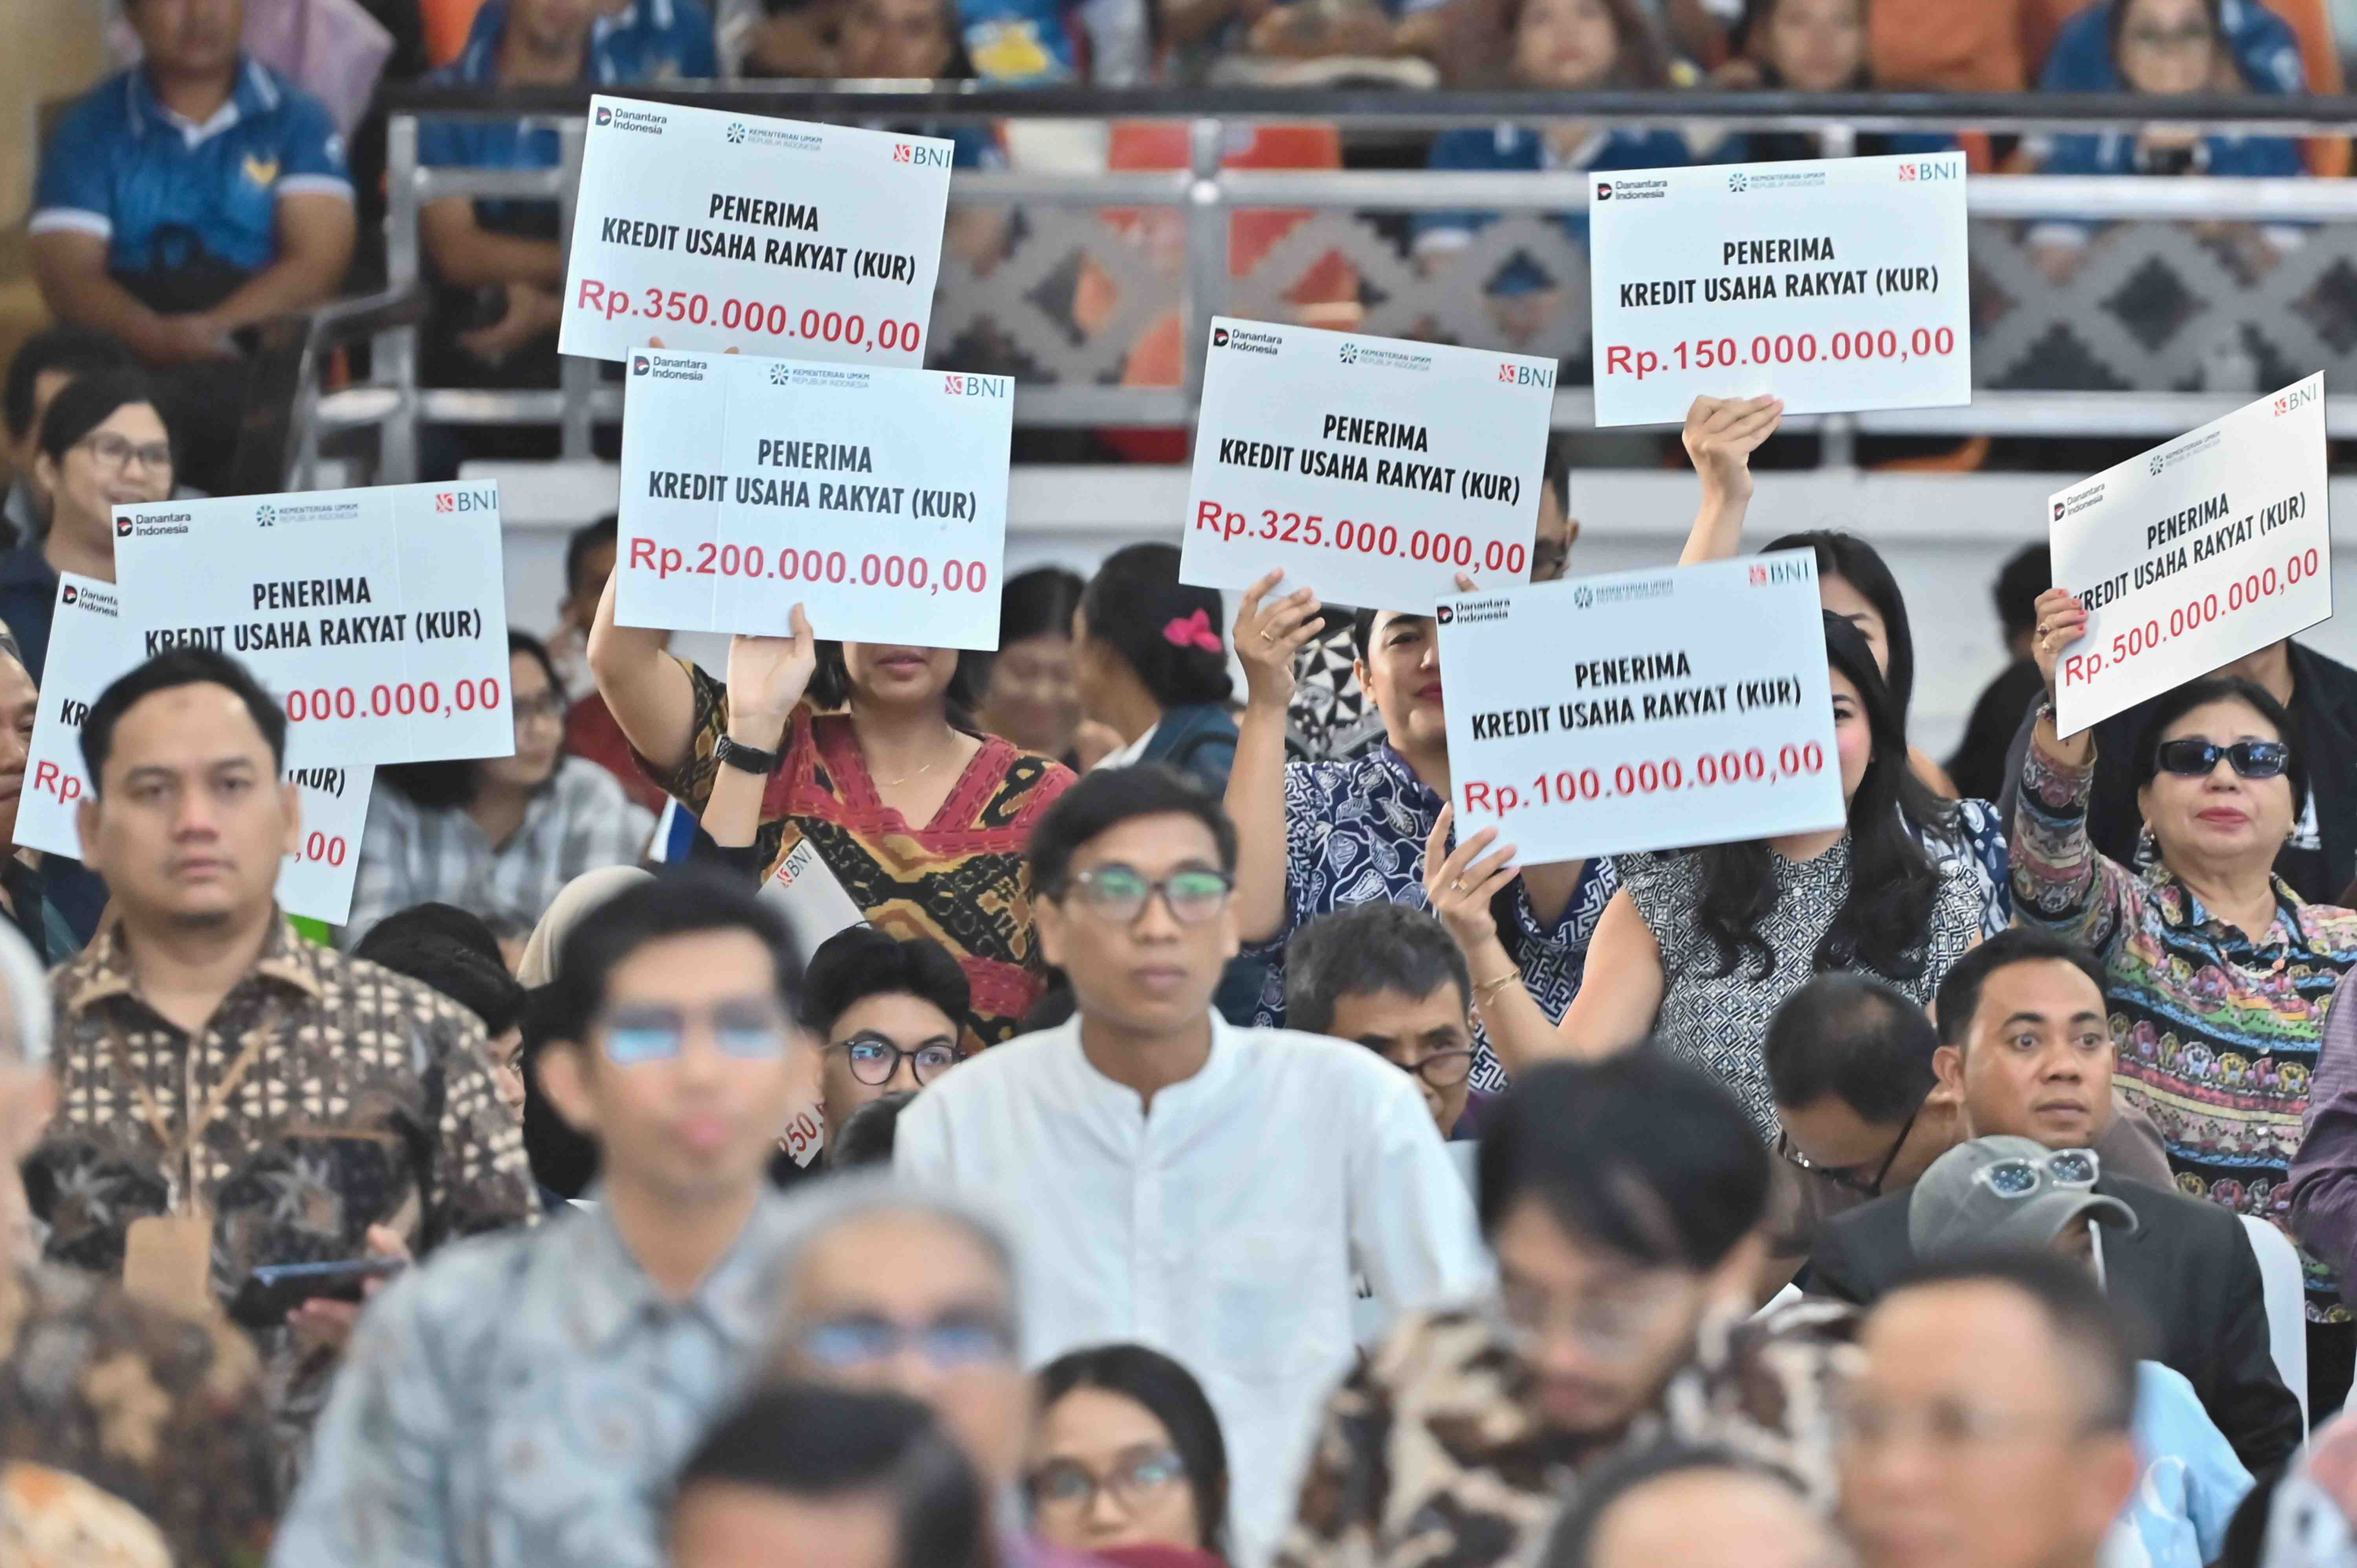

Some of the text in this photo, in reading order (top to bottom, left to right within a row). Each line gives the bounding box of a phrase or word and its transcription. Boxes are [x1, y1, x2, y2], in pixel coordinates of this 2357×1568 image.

[614, 119, 662, 135] Indonesia
[615, 108, 667, 124] Danantara
[913, 146, 951, 168] BNI
[1920, 162, 1956, 180] BNI
[1615, 180, 1668, 190] Danantara
[1616, 191, 1665, 200] Indonesia
[709, 194, 818, 232] PENERIMA
[602, 217, 915, 286] KREDIT USAHA RAKYAT (KUR)
[1724, 237, 1835, 266] PENERIMA
[1620, 265, 1938, 308] KREDIT USAHA RAKYAT (KUR)
[579, 280, 920, 352] Rp.350.000.000,00
[1230, 340, 1278, 355] Indonesia
[1232, 329, 1282, 344] Danantara
[653, 356, 707, 370] Danantara
[1607, 327, 1954, 380] Rp.150.000.000,00
[652, 368, 703, 381] Indonesia
[966, 377, 1004, 398] BNI
[1518, 366, 1553, 388] BNI
[2289, 383, 2317, 411] BNI
[1323, 414, 1428, 452] PENERIMA
[758, 439, 872, 473] PENERIMA
[1219, 438, 1520, 506] KREDIT USAHA RAKYAT (KUR)
[458, 490, 497, 512] BNI
[649, 471, 976, 523] KREDIT USAHA RAKYAT (KUR)
[2067, 484, 2105, 506] Danantara
[2067, 495, 2103, 516] Indonesia
[136, 513, 191, 524] Danantara
[136, 526, 189, 536] Indonesia
[2147, 493, 2229, 550] PENERIMA
[1197, 500, 1525, 573] Rp.325.000.000,00
[2134, 547, 2188, 590] USAHA
[2194, 515, 2254, 564] RAKYAT
[2260, 491, 2305, 536] (KUR)
[630, 538, 986, 595] Rp.200.000.000,00
[1770, 561, 1808, 583] BNI
[81, 588, 117, 605] Dananta
[253, 577, 371, 610] PENERIMA
[1456, 599, 1510, 612] Danantara
[79, 599, 117, 617] Indonesi
[1457, 610, 1508, 624] Indonesia
[2065, 548, 2318, 687] Rp.500.000.000,00
[234, 621, 312, 651] USAHA
[320, 614, 407, 646] RAKYAT
[416, 608, 481, 643] (KUR)
[1575, 652, 1691, 689] PENERIMA
[287, 678, 499, 722] 000.000,00
[1472, 674, 1801, 740] KREDIT USAHA RAKYAT (KUR)
[1464, 742, 1824, 817] Rp.100.000.000,00
[786, 844, 812, 878] BNI
